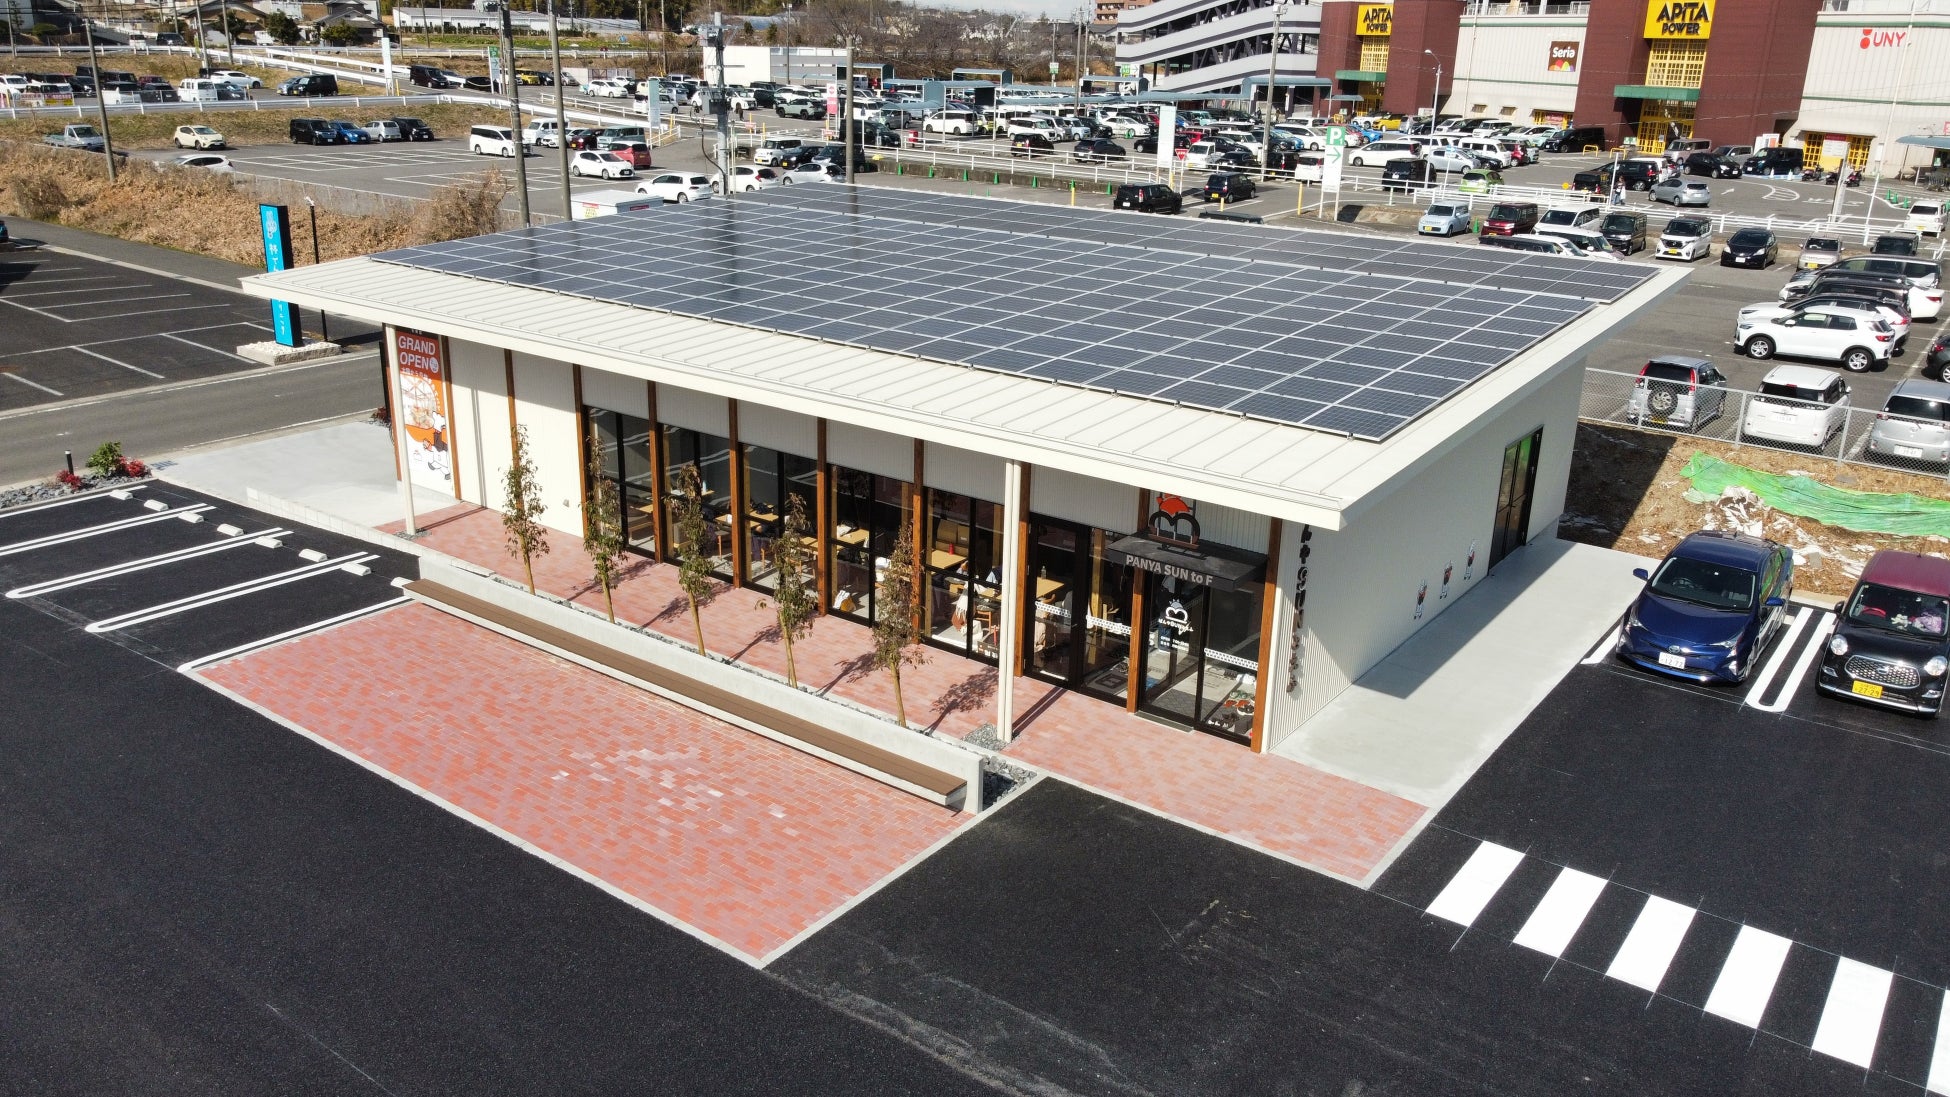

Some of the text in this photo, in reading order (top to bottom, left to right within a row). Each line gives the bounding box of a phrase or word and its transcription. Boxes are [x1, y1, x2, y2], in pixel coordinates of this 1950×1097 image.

[1363, 8, 1392, 23] APITA
[1655, 2, 1710, 23] APITA
[1366, 23, 1388, 33] POWER
[1661, 23, 1701, 35] POWER
[1873, 31, 1907, 47] UNY
[1552, 46, 1576, 58] Seria
[398, 335, 436, 356] GRAND
[400, 351, 429, 370] OPEN
[1125, 554, 1214, 586] PANYA SUN to F
